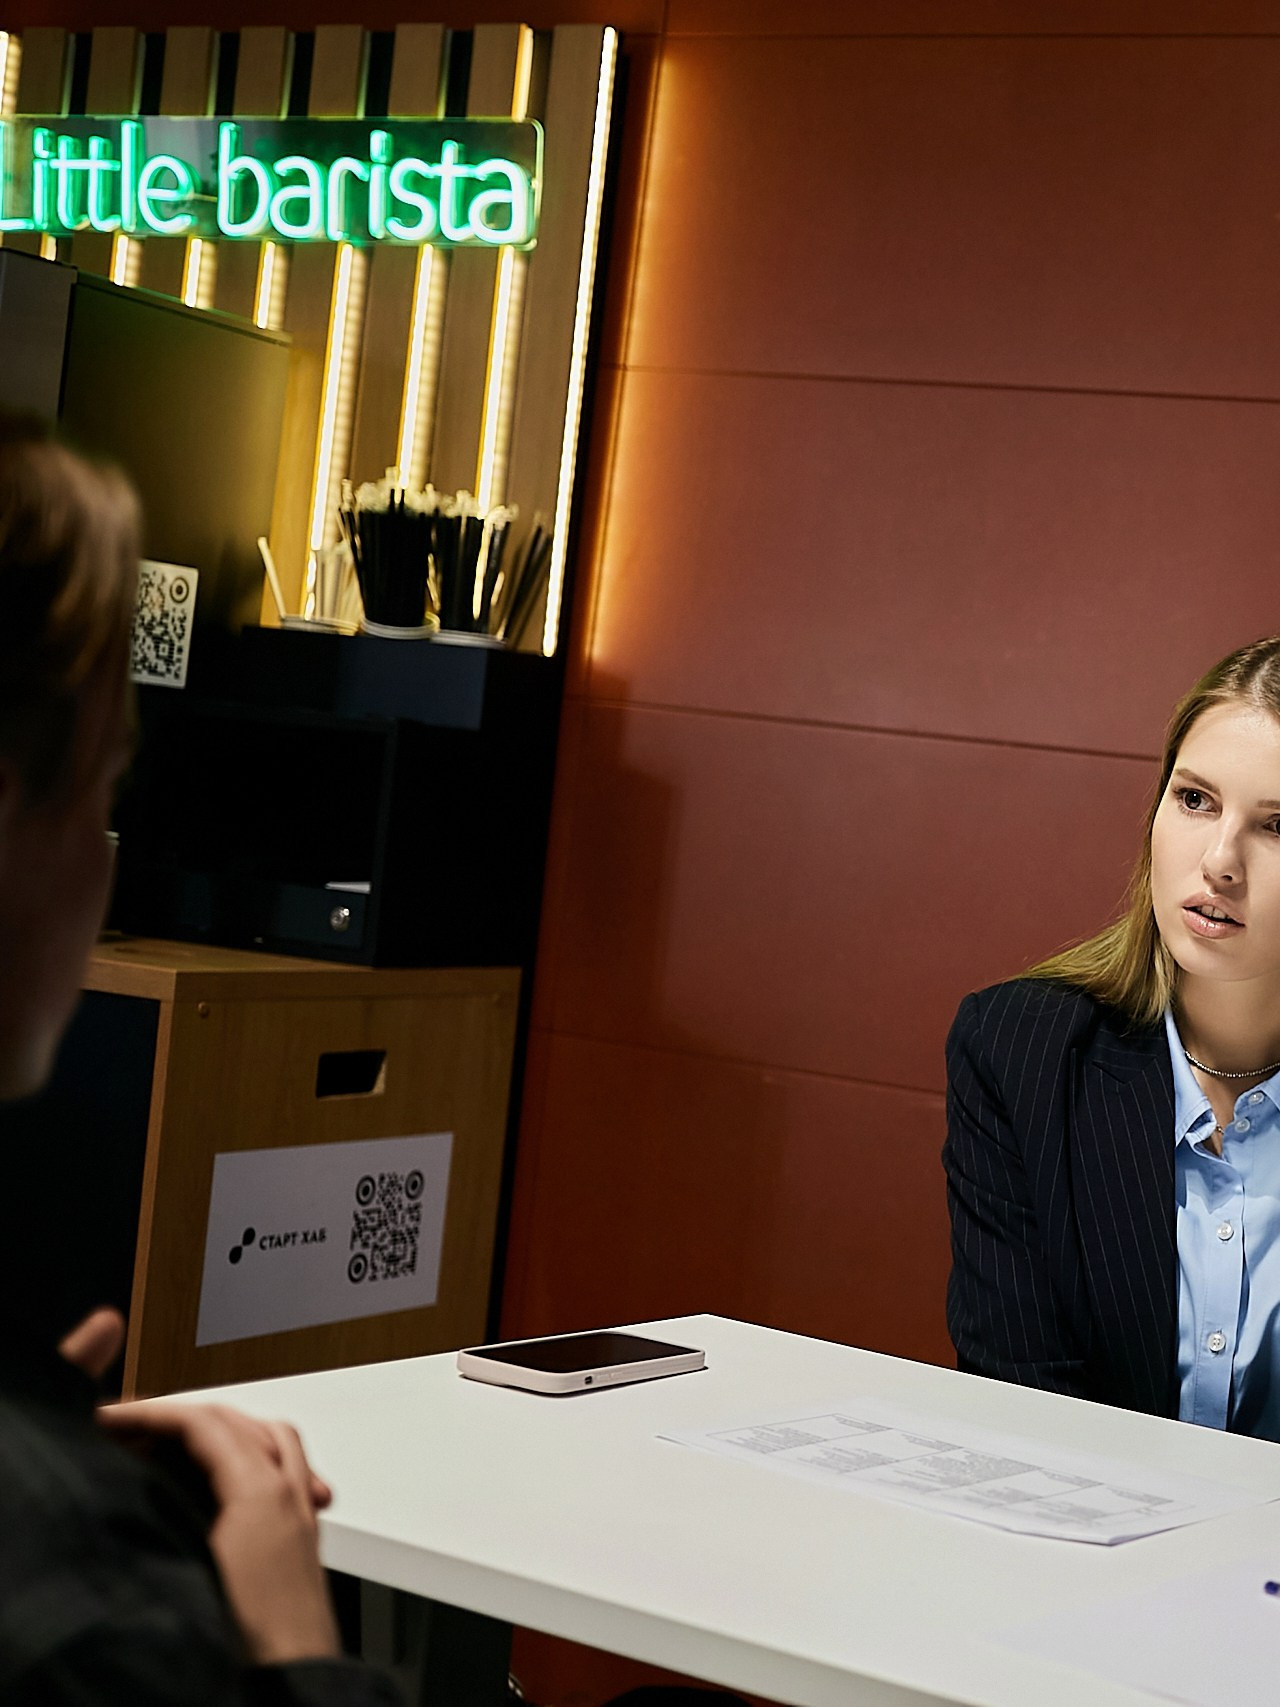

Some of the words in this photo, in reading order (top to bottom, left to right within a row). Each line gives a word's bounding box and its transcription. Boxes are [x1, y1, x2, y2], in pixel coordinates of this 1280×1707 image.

[0, 119, 196, 233] Little
[216, 121, 529, 243] barista
[259, 1231, 298, 1251] СТАРТ
[301, 1227, 327, 1245] ХАБ
